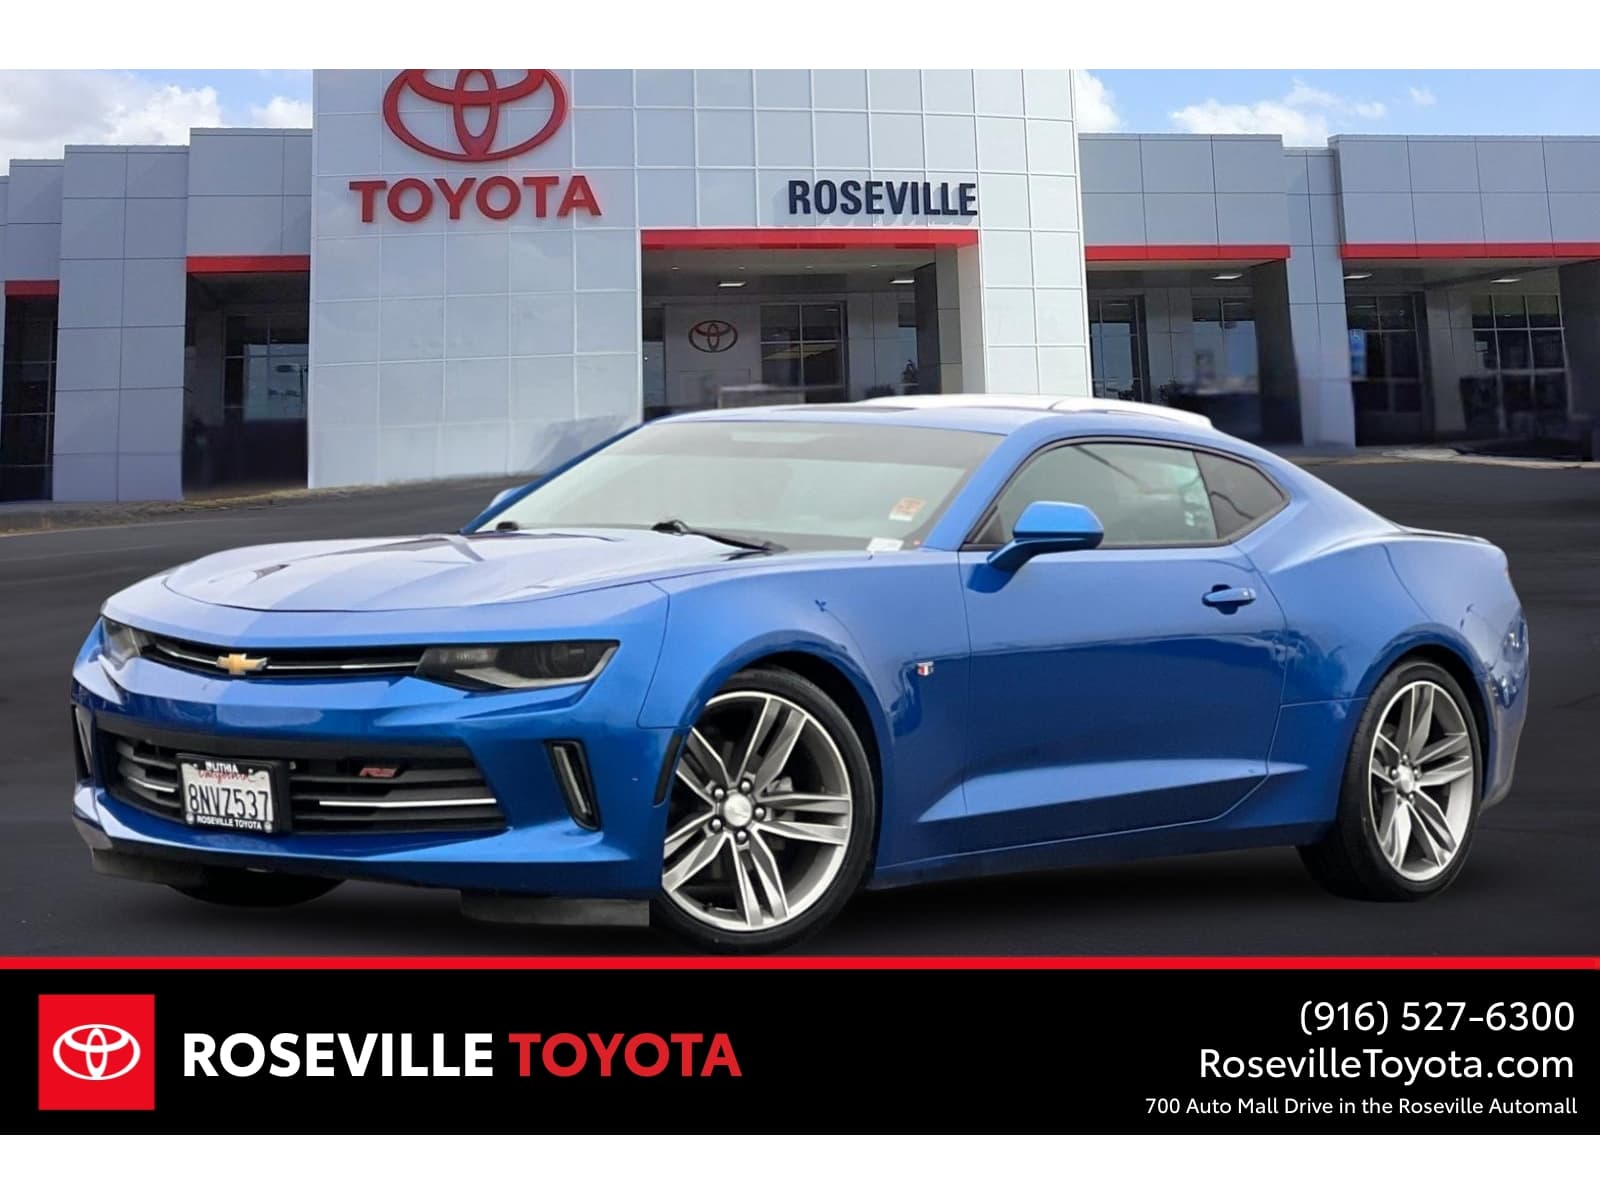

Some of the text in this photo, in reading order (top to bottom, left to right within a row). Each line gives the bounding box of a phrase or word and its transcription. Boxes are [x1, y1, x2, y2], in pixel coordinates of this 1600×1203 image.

[349, 175, 602, 223] TOYOTA
[788, 180, 978, 217] ROSEVILLE
[188, 783, 269, 822] 8NVZ537
[196, 815, 262, 830] ROSEVILLE TOYOTA
